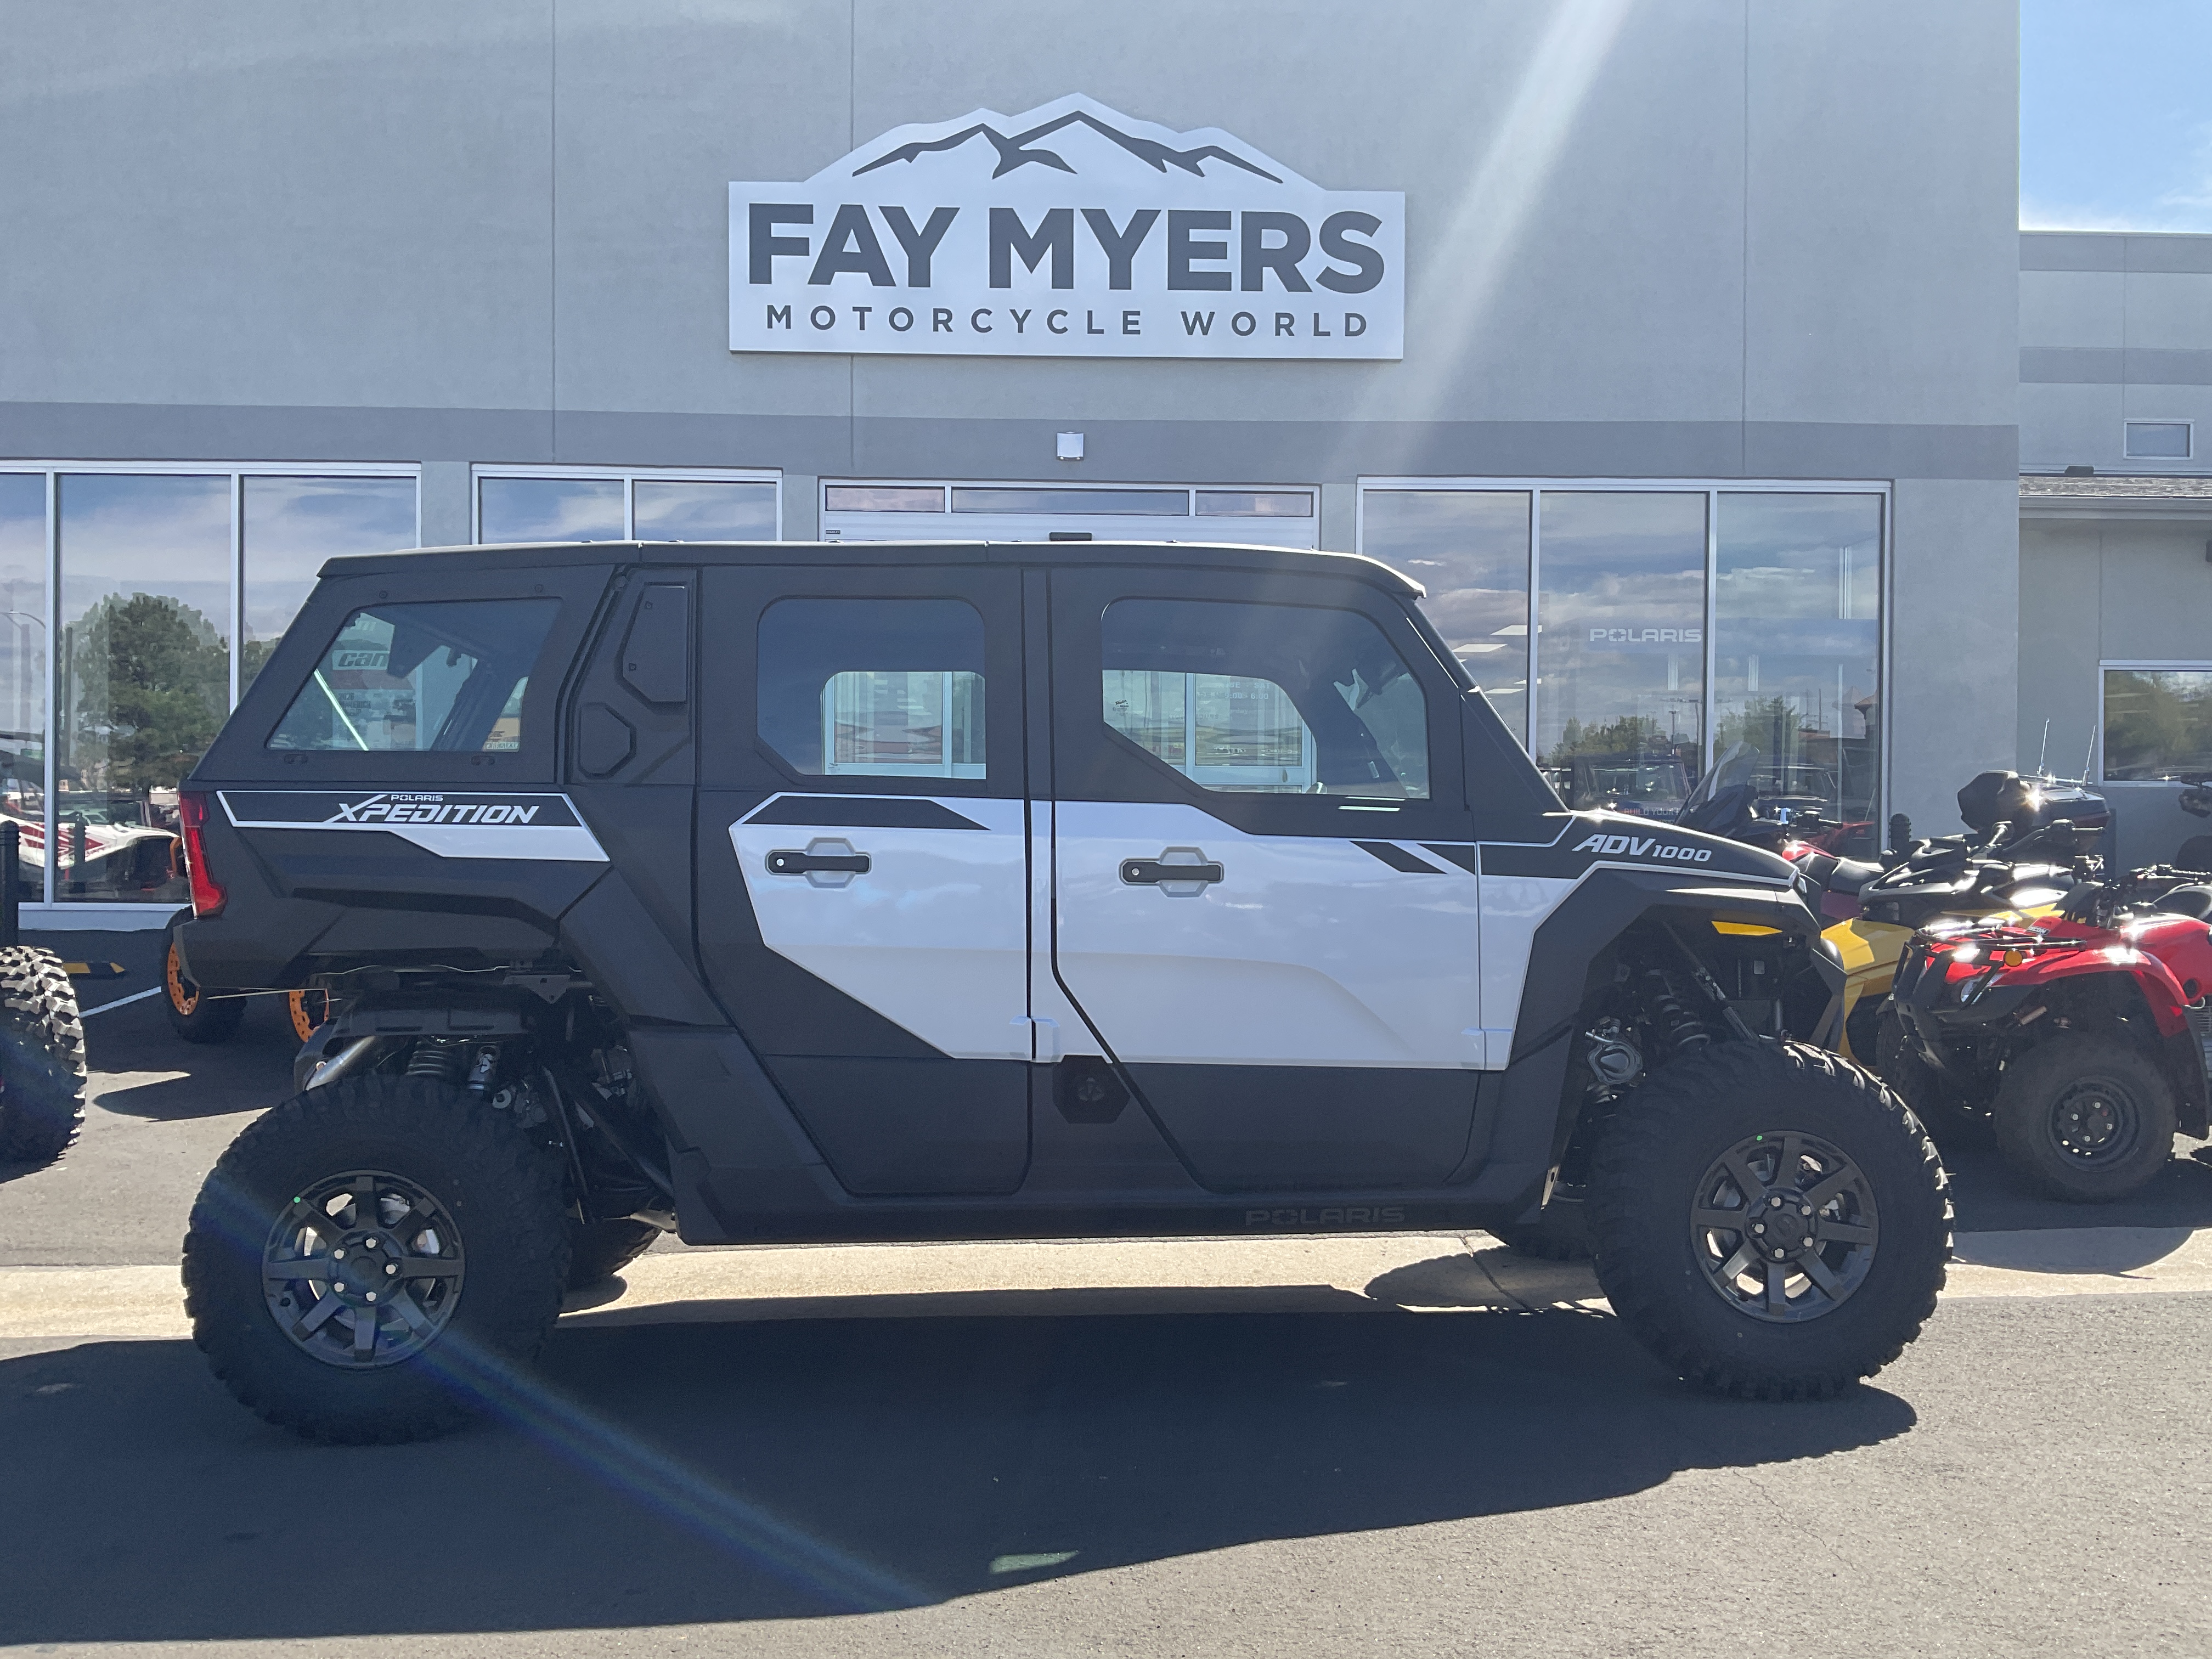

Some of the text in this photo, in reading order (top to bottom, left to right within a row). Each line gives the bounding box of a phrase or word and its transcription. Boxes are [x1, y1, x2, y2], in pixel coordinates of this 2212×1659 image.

[748, 203, 1385, 294] FAY MYERS
[768, 305, 1368, 337] MOTORCYCLE WORLD
[1590, 628, 1701, 642] POLARIS
[323, 794, 539, 823] XPEDITION
[1572, 834, 1712, 862] ADV 1000
[1246, 1207, 1405, 1226] POLARIS
